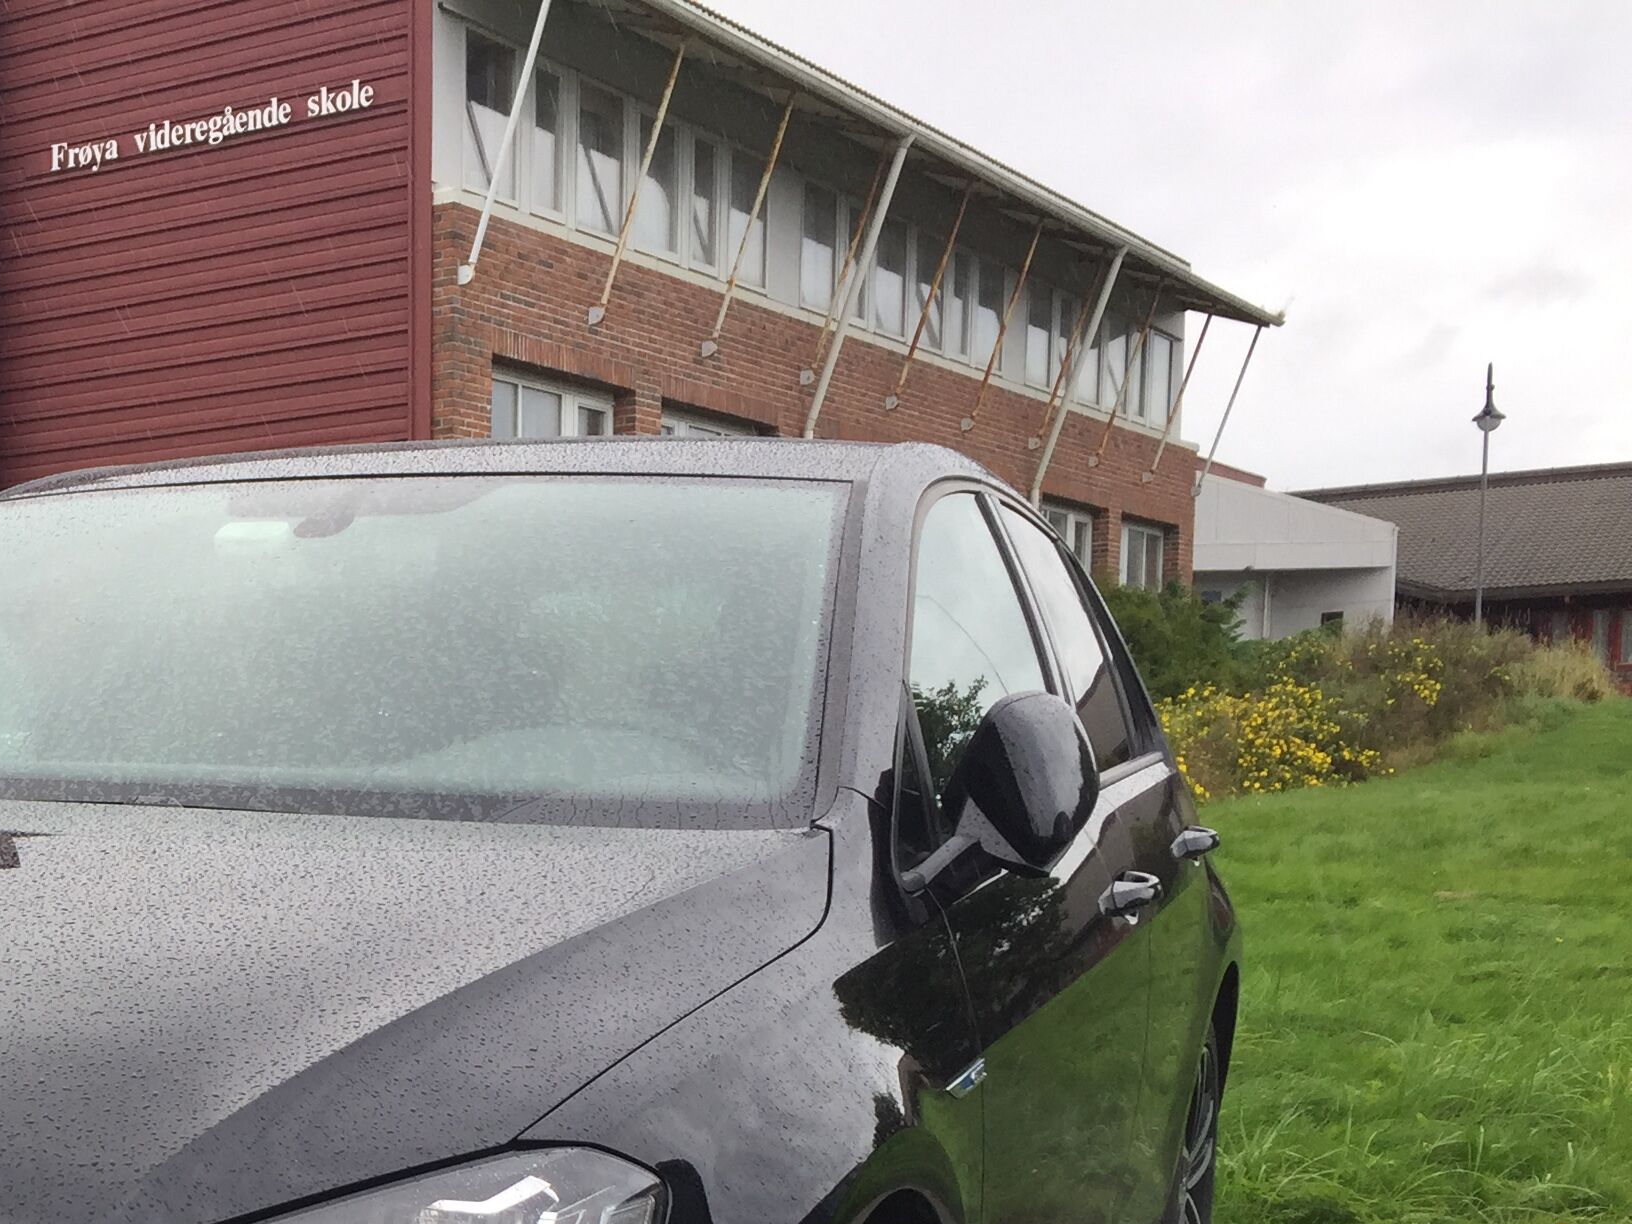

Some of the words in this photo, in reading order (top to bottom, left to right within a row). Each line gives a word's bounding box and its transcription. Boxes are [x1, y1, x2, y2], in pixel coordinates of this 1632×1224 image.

[50, 139, 118, 172] Frøya
[133, 97, 292, 153] videregående
[307, 78, 374, 117] skole
